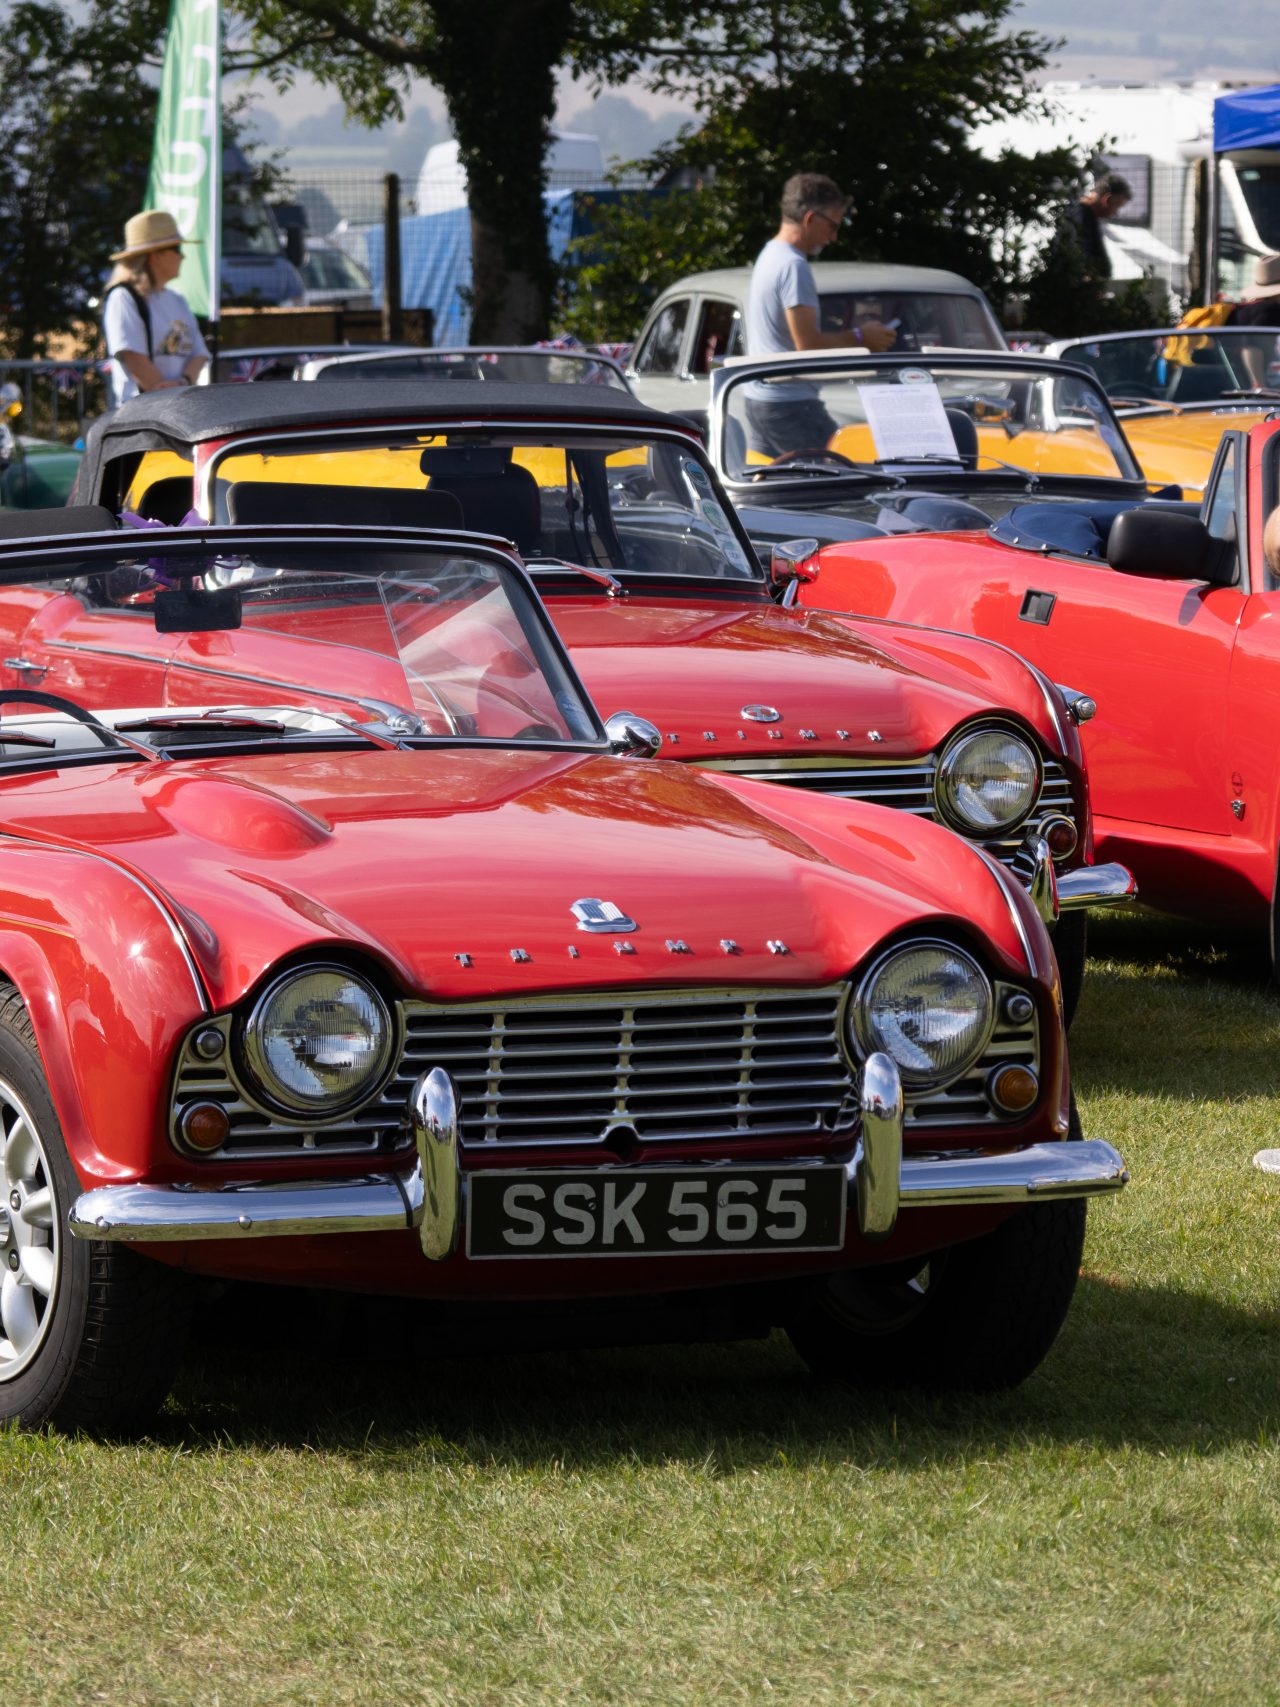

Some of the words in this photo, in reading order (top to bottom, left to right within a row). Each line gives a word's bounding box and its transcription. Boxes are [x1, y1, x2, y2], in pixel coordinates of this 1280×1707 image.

[667, 728, 883, 743] TRIUMPH
[453, 939, 789, 968] TRIUMPH
[502, 1182, 646, 1246] SSK
[667, 1179, 807, 1243] 565
